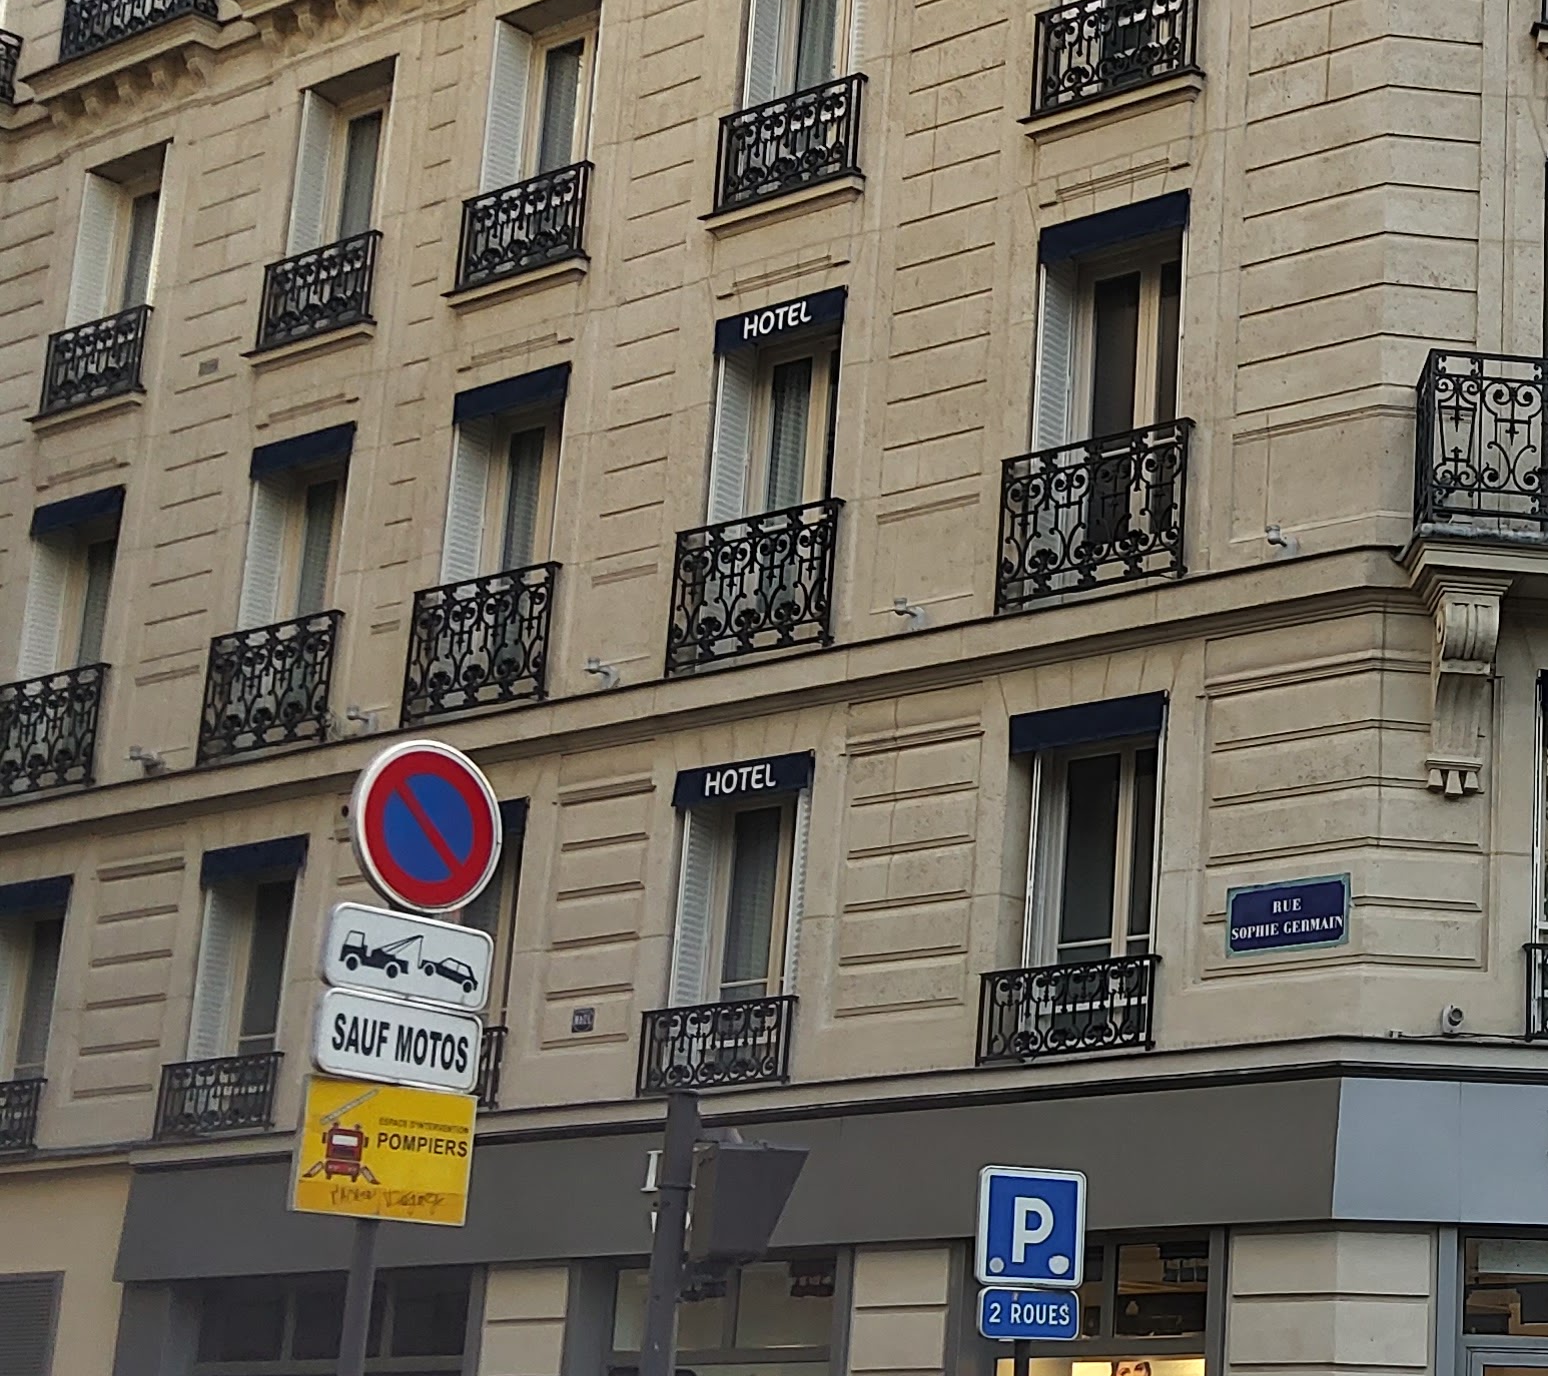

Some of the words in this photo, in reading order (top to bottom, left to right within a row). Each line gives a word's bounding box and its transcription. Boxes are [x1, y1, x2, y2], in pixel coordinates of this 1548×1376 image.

[743, 301, 812, 340] HOTEL
[704, 763, 776, 797] HOTEL
[1272, 898, 1302, 913] RUE
[1231, 923, 1279, 940] SOPHIE
[1283, 915, 1344, 934] GERMAIN
[332, 1013, 390, 1057] SAUF
[395, 1025, 469, 1073] MOTOS
[377, 1132, 468, 1158] POMPIERS
[1012, 1196, 1054, 1263] P
[989, 1302, 1001, 1323] 2
[1011, 1303, 1070, 1325] ROUES
